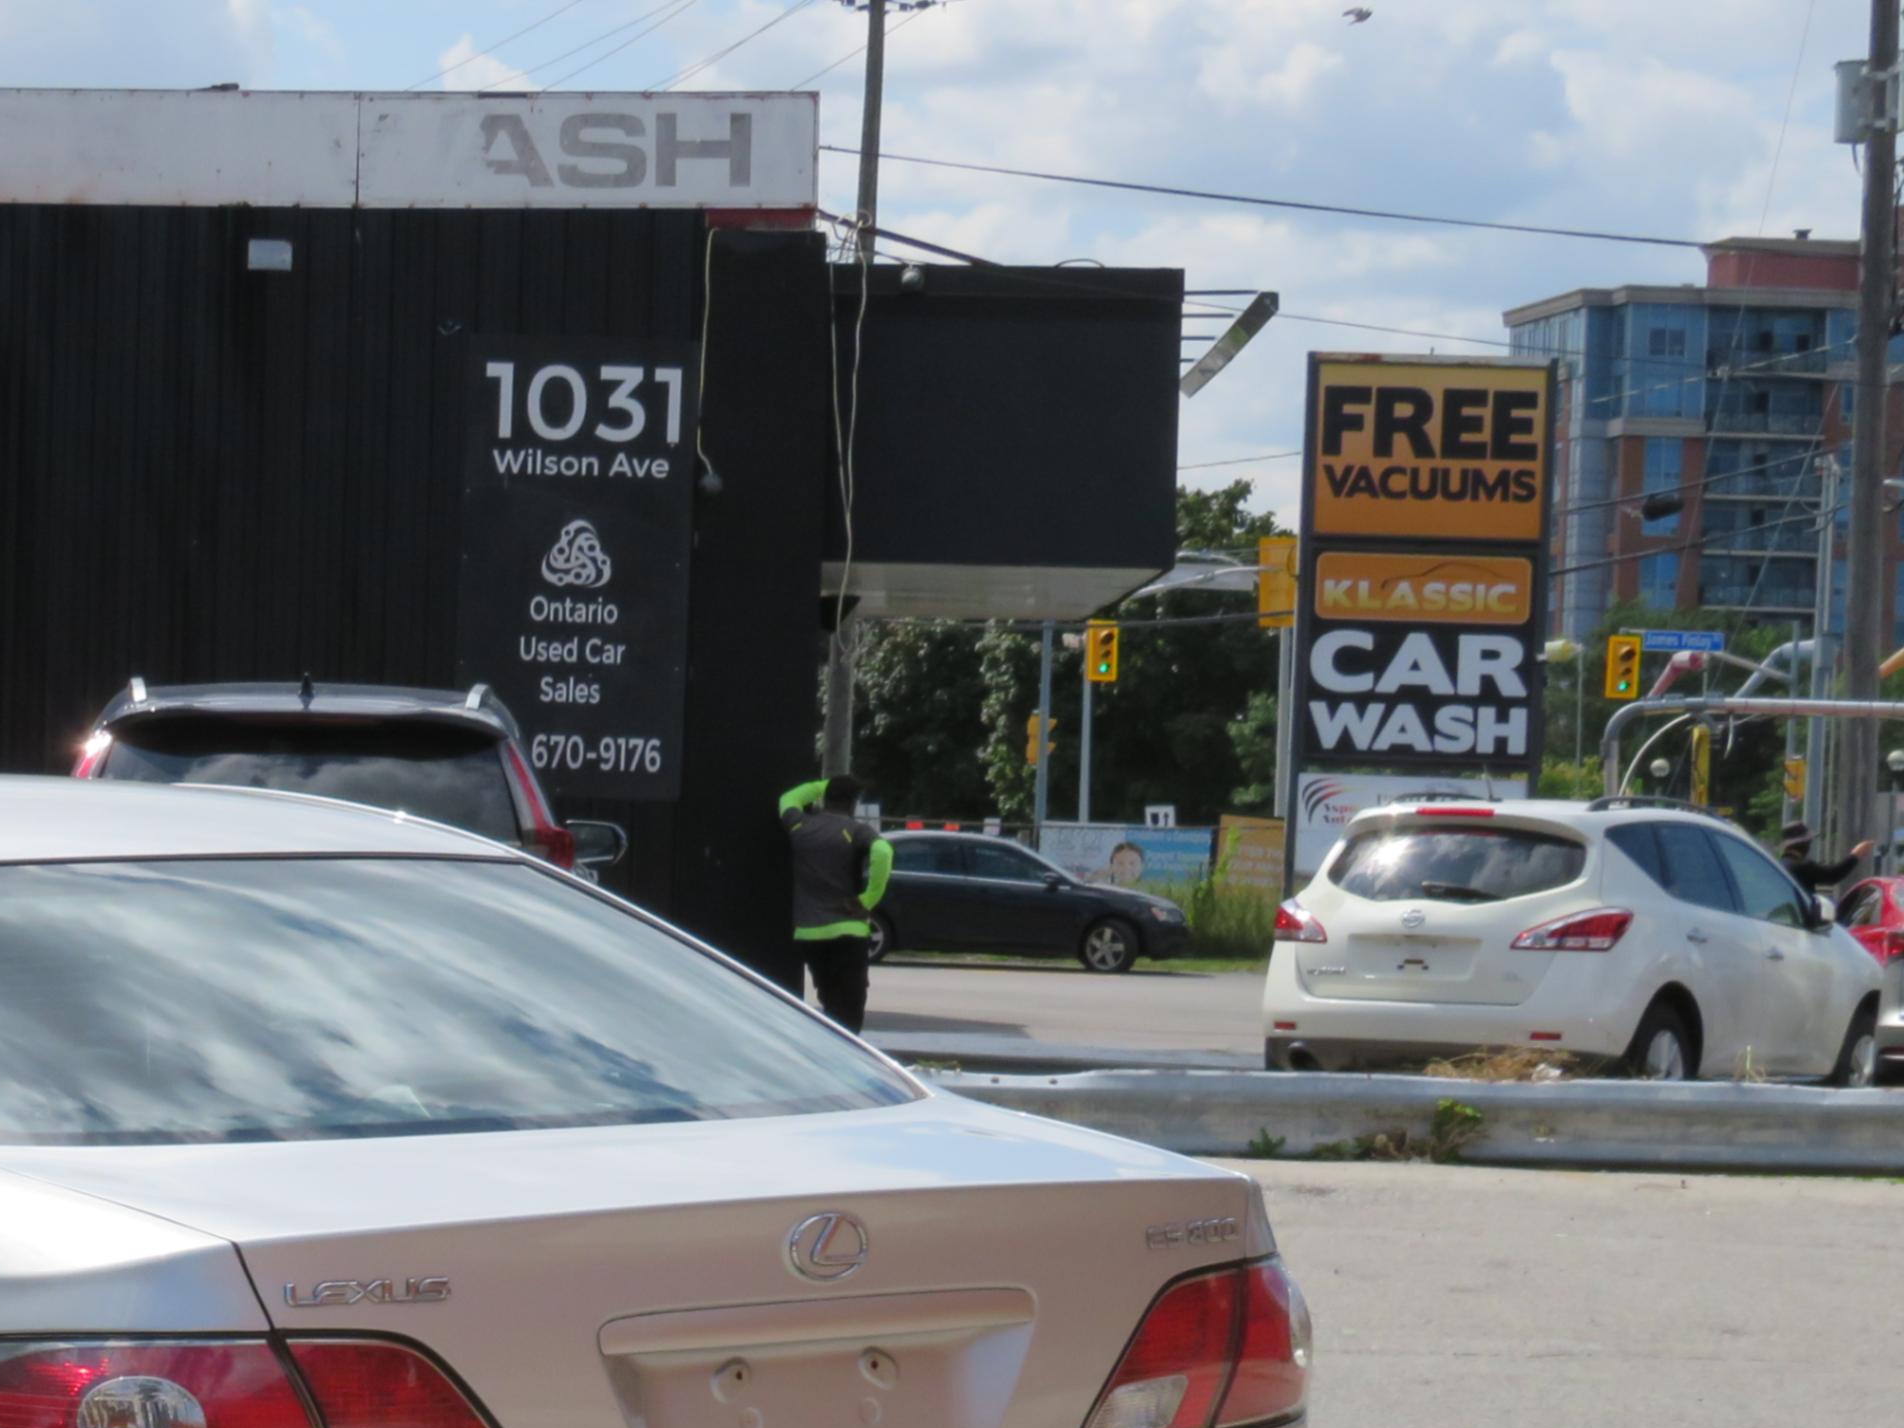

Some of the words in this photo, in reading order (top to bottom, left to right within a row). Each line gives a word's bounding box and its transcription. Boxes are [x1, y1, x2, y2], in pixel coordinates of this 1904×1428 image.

[479, 112, 753, 188] ASH
[486, 362, 682, 444] 1031
[1321, 385, 1538, 461] FREE
[493, 448, 599, 476] Wilson
[608, 452, 670, 478] Ave
[1322, 463, 1537, 503] VACUUMS
[529, 596, 619, 624] Ontario
[1322, 578, 1518, 614] KLASSIC
[520, 636, 578, 662] Used
[585, 638, 626, 664] Car
[1309, 629, 1527, 697] CAR
[540, 676, 601, 704] Sales
[1308, 701, 1528, 755] WASH
[531, 734, 661, 773] 670-9176
[284, 1277, 451, 1307] LEXUS
